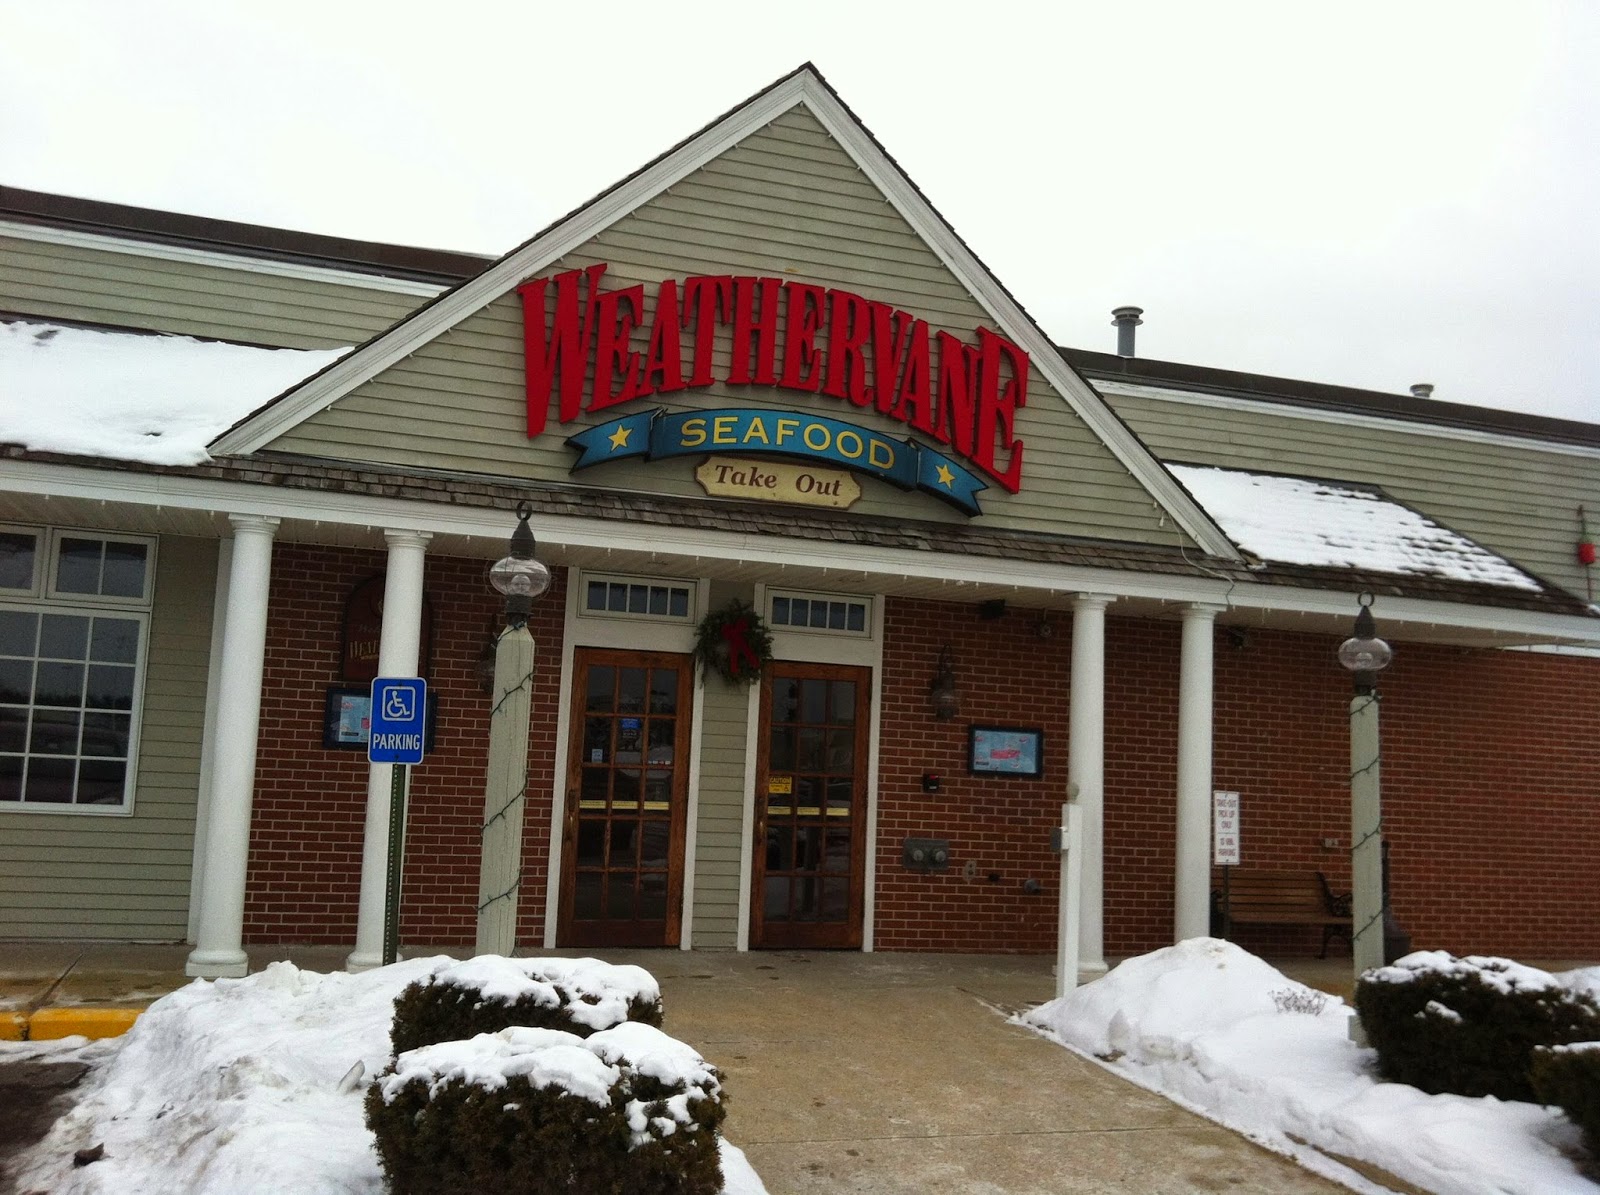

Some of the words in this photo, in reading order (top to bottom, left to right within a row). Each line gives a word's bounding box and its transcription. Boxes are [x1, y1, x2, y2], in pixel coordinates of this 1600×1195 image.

[516, 263, 1029, 494] WEATHERVANE
[680, 416, 896, 470] SEAFOOD
[714, 465, 778, 490] Take
[795, 474, 842, 497] Out
[372, 733, 420, 751] PARKING
